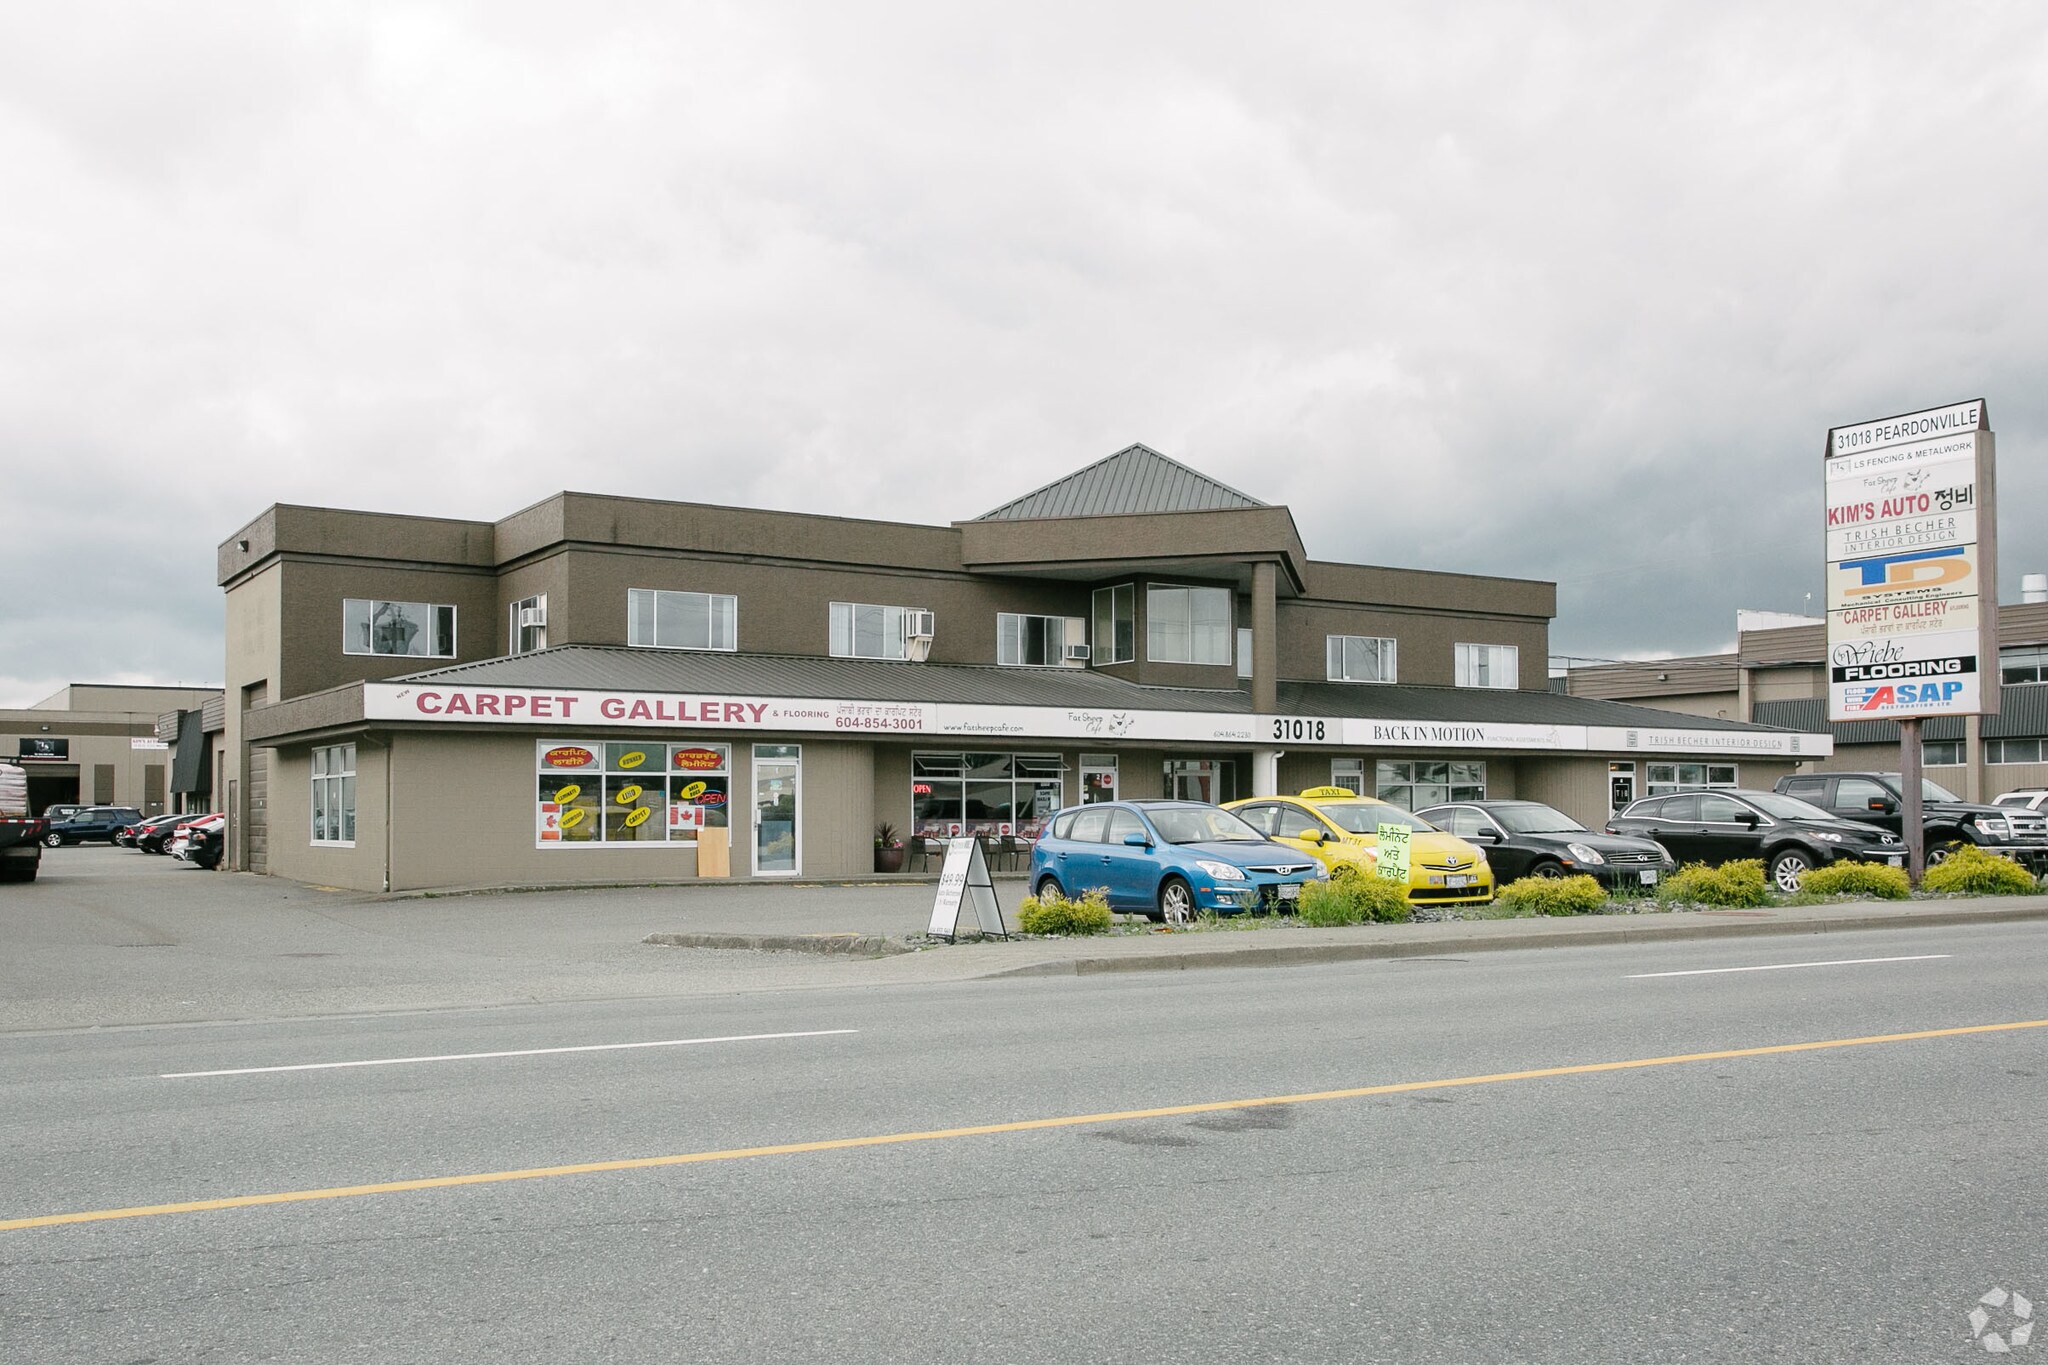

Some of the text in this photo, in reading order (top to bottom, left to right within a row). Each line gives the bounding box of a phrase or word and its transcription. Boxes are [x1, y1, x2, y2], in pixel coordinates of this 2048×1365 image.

[1838, 409, 1977, 449] 31018 PEARDONVILLE
[1854, 459, 1864, 468] LS
[1867, 451, 1904, 466] FENCING
[1907, 452, 1913, 460] &
[1915, 442, 1972, 458] METALWORK
[1934, 484, 1973, 511] 정비
[1828, 493, 1930, 526] KIM'S AUTO
[1845, 517, 1956, 542] TRISH BECHER
[1844, 530, 1956, 553] INTERIOR DESIGN
[1839, 547, 1972, 597] TD
[1841, 590, 1963, 608] Mechanical Consulting Engineers
[1861, 587, 1943, 600] SYSTEMS
[1843, 607, 1889, 624] CARPET
[1893, 600, 1948, 620] GALLERY
[1833, 640, 1904, 667] Wiebe
[1844, 659, 1961, 680] FLOORING
[397, 689, 410, 699] NEW
[416, 692, 578, 718] CARPET
[600, 698, 769, 723] GALLERY
[783, 710, 829, 719] FLOORING
[1862, 681, 1963, 710] ASAP
[836, 717, 922, 729] 604-854-3001
[1273, 719, 1325, 740] 31018
[1374, 725, 1485, 741] BACK IN MOTION
[1649, 736, 1782, 748] TRISH BECHER INTERIOR DESIGN
[697, 793, 726, 804] OPEN
[914, 784, 931, 793] OPEN
[1320, 788, 1340, 796] TAXI
[628, 809, 647, 824] CARPET
